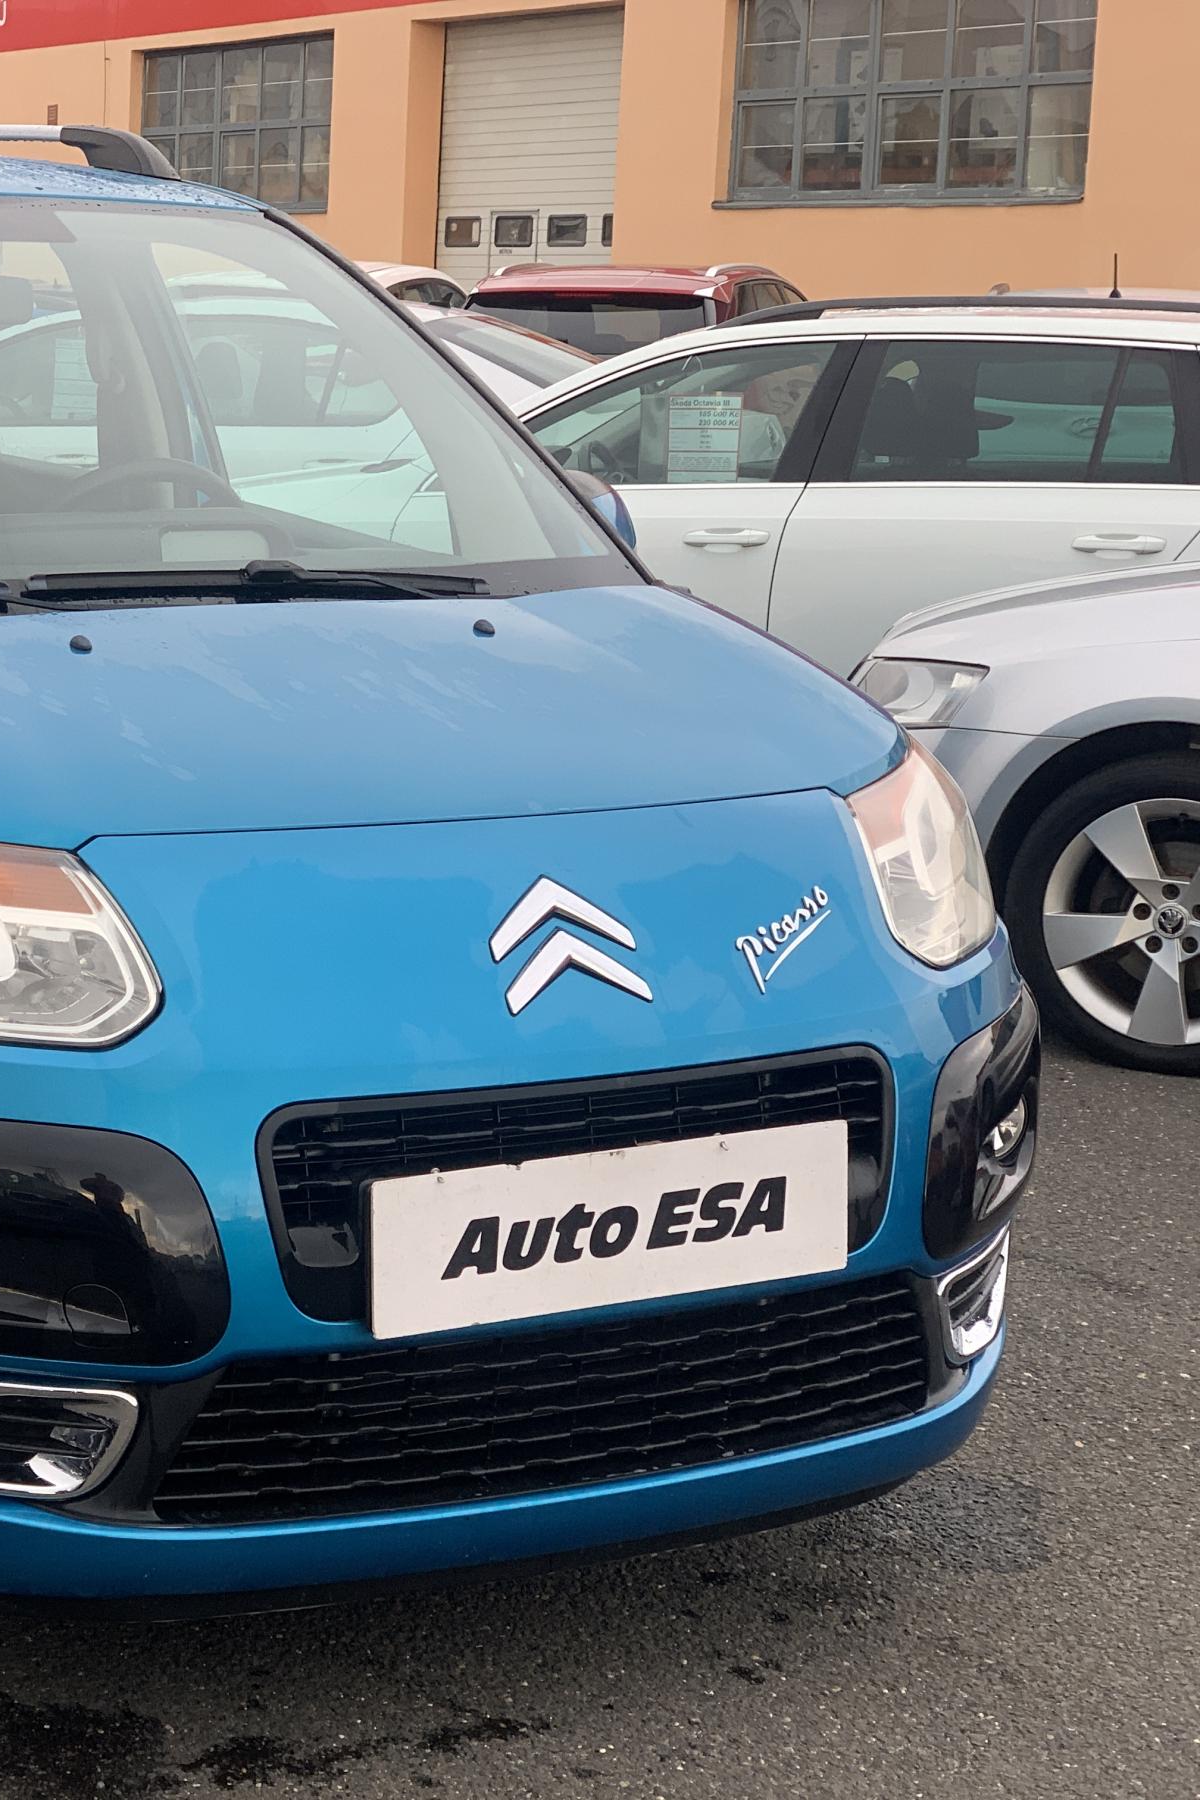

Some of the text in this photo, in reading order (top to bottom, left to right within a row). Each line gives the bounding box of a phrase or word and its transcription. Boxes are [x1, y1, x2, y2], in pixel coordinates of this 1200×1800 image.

[736, 886, 831, 994] Picasso
[441, 1176, 787, 1280] Auto ESA
